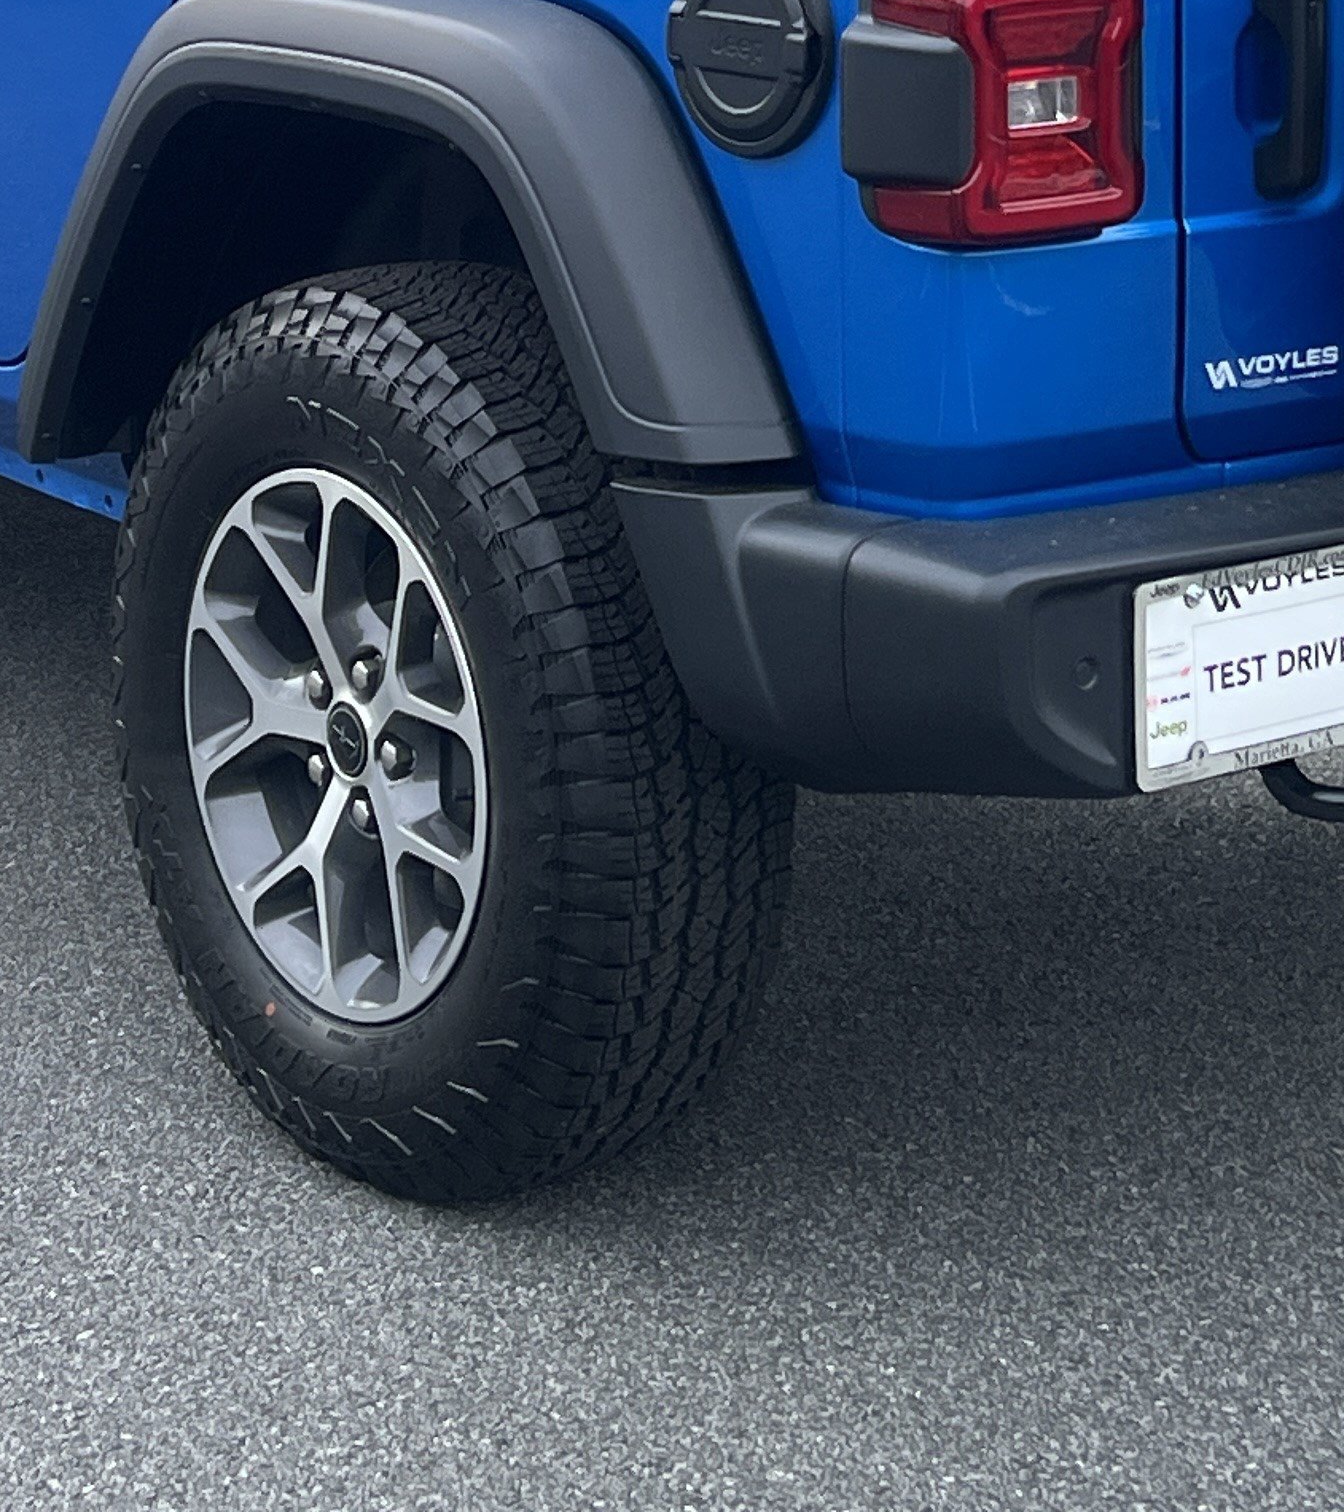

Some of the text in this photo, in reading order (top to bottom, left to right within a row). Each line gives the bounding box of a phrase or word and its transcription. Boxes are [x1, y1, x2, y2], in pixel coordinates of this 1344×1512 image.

[1238, 345, 1339, 376] VOYLES
[1203, 654, 1267, 692] TEST
[1149, 719, 1188, 740] Jeep
